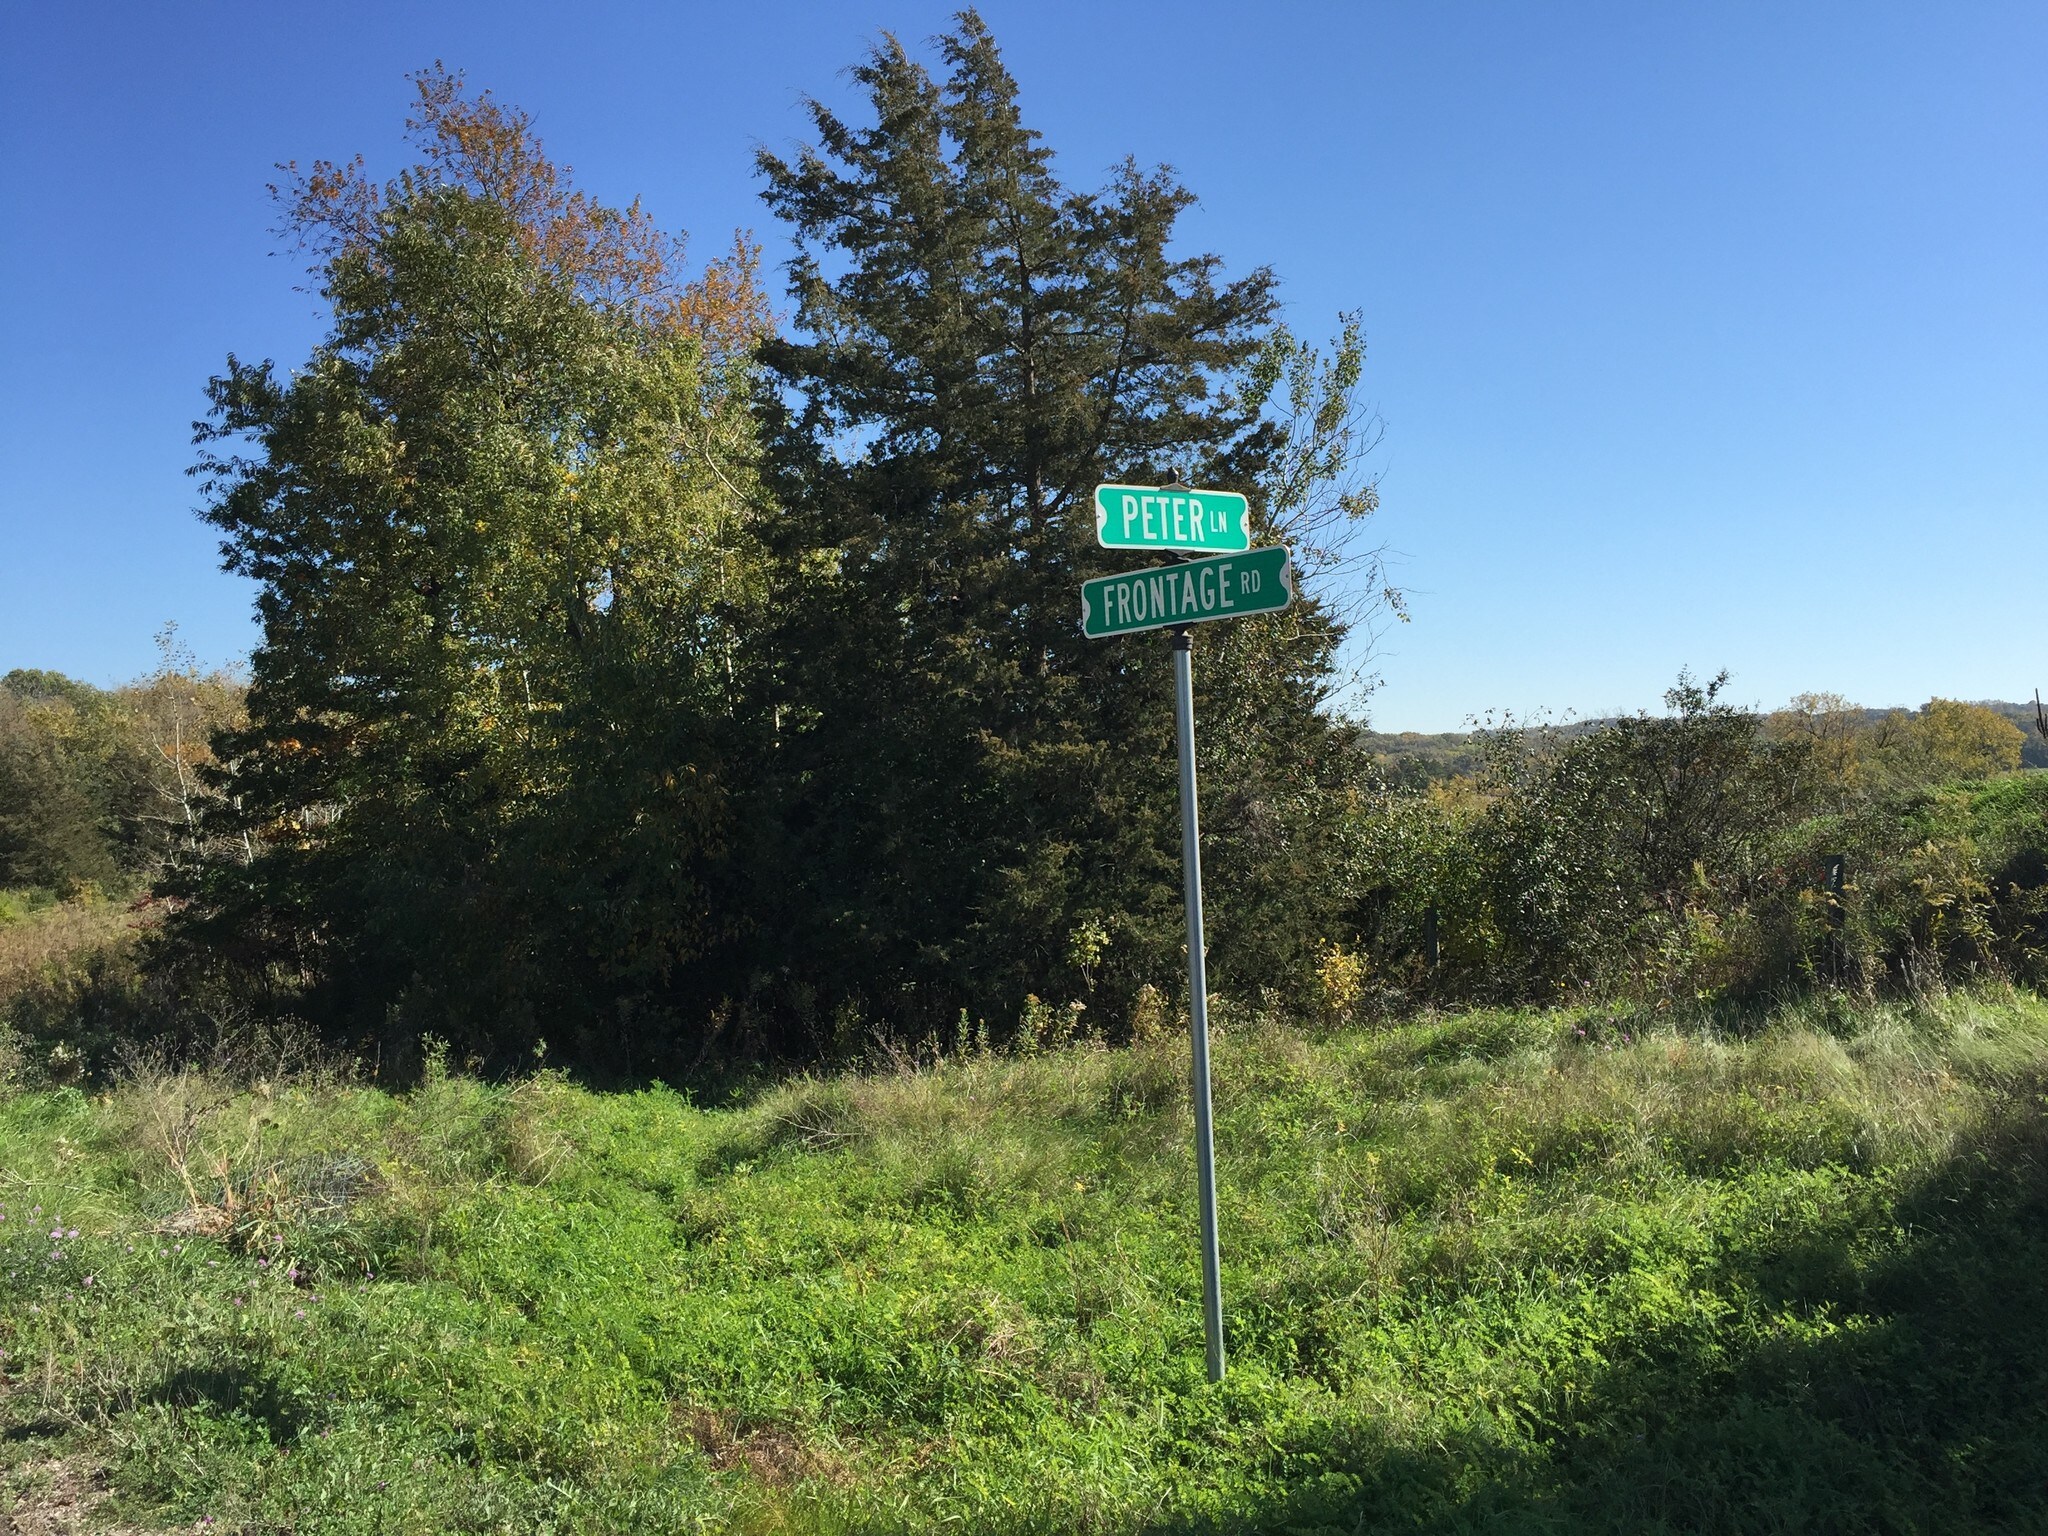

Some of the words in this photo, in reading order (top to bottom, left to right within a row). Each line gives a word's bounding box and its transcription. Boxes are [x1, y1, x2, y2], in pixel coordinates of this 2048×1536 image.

[1121, 495, 1205, 542] PETER
[1210, 510, 1228, 533] LN
[1103, 563, 1234, 626] FRONTAGE
[1240, 569, 1261, 595] RD
